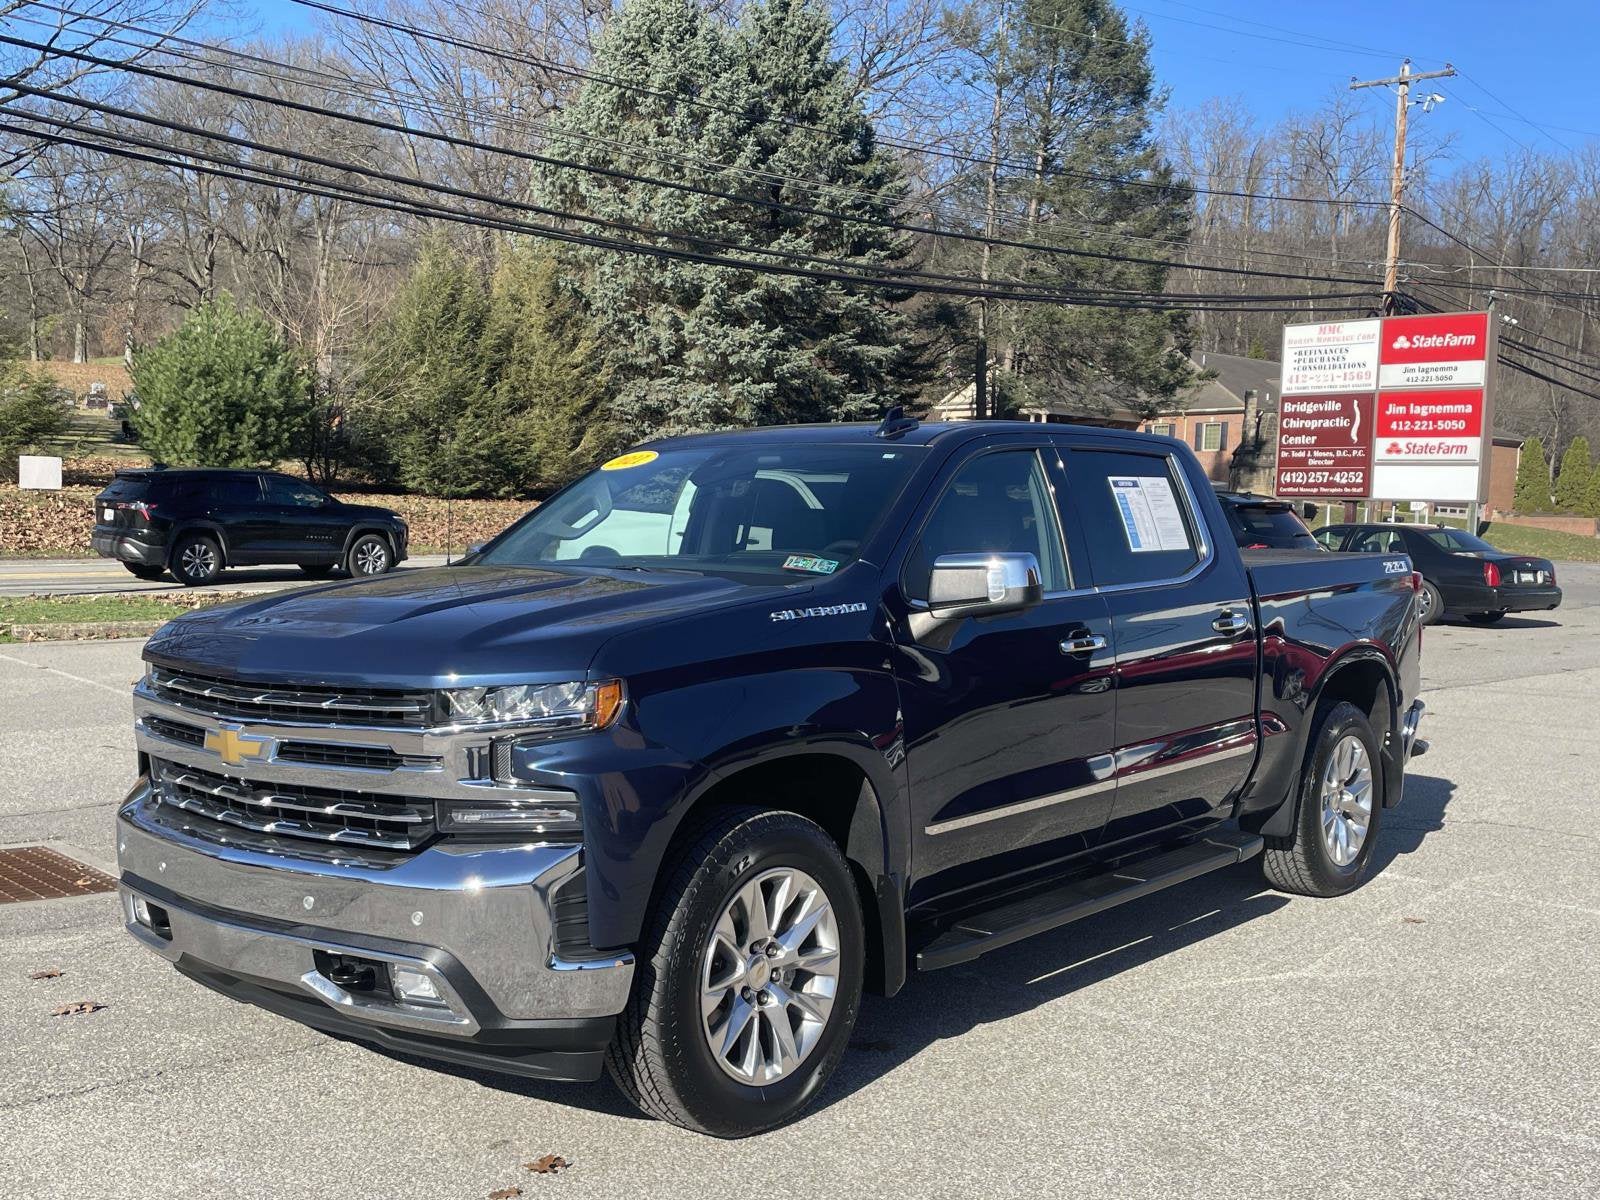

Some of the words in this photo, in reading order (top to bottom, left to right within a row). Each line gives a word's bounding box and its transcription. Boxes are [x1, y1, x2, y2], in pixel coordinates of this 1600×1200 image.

[1298, 347, 1349, 357] REFINANCES
[1297, 354, 1346, 364] PURCHASES
[1297, 361, 1367, 371] CONSOLIDATIONS
[1402, 366, 1416, 374] Jim
[1406, 374, 1453, 383] 412-221-5050
[1283, 400, 1342, 414] Bridgeville
[1385, 403, 1406, 415] Jim
[1409, 402, 1473, 417] Iagnemma
[1282, 416, 1351, 430] Chiropractic
[1390, 420, 1466, 431] 412-221-5050
[1281, 434, 1317, 445] Center
[1280, 450, 1291, 458] Dr.
[1291, 450, 1306, 458] Todd
[1308, 458, 1335, 466] Director
[769, 602, 868, 622] SILVERADO
